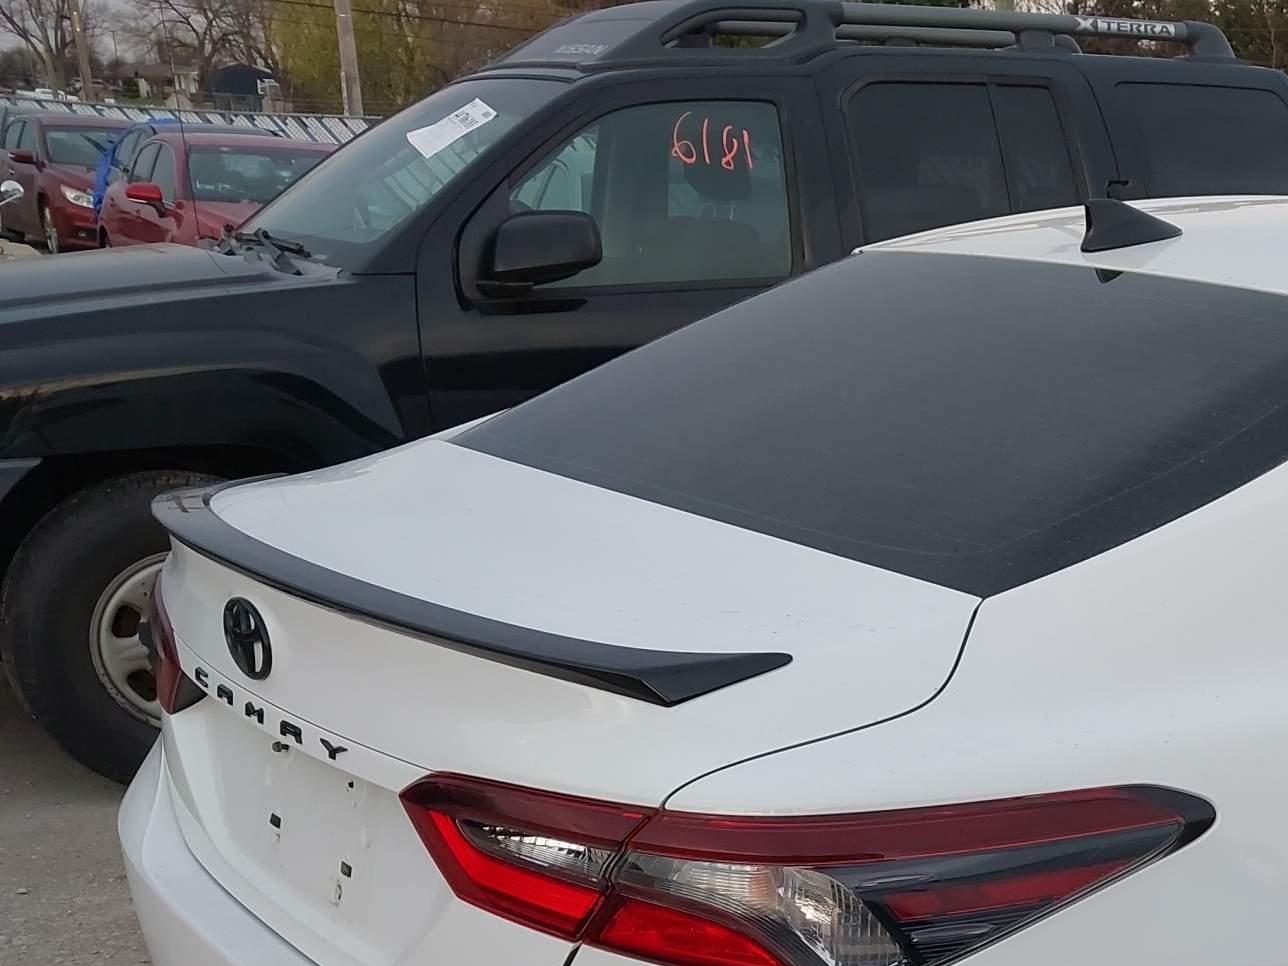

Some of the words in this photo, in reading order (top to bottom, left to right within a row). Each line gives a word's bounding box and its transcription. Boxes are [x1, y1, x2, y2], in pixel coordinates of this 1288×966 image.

[1073, 15, 1174, 37] XTERRA
[672, 111, 752, 170] 6181
[194, 666, 349, 761] CAMRY
